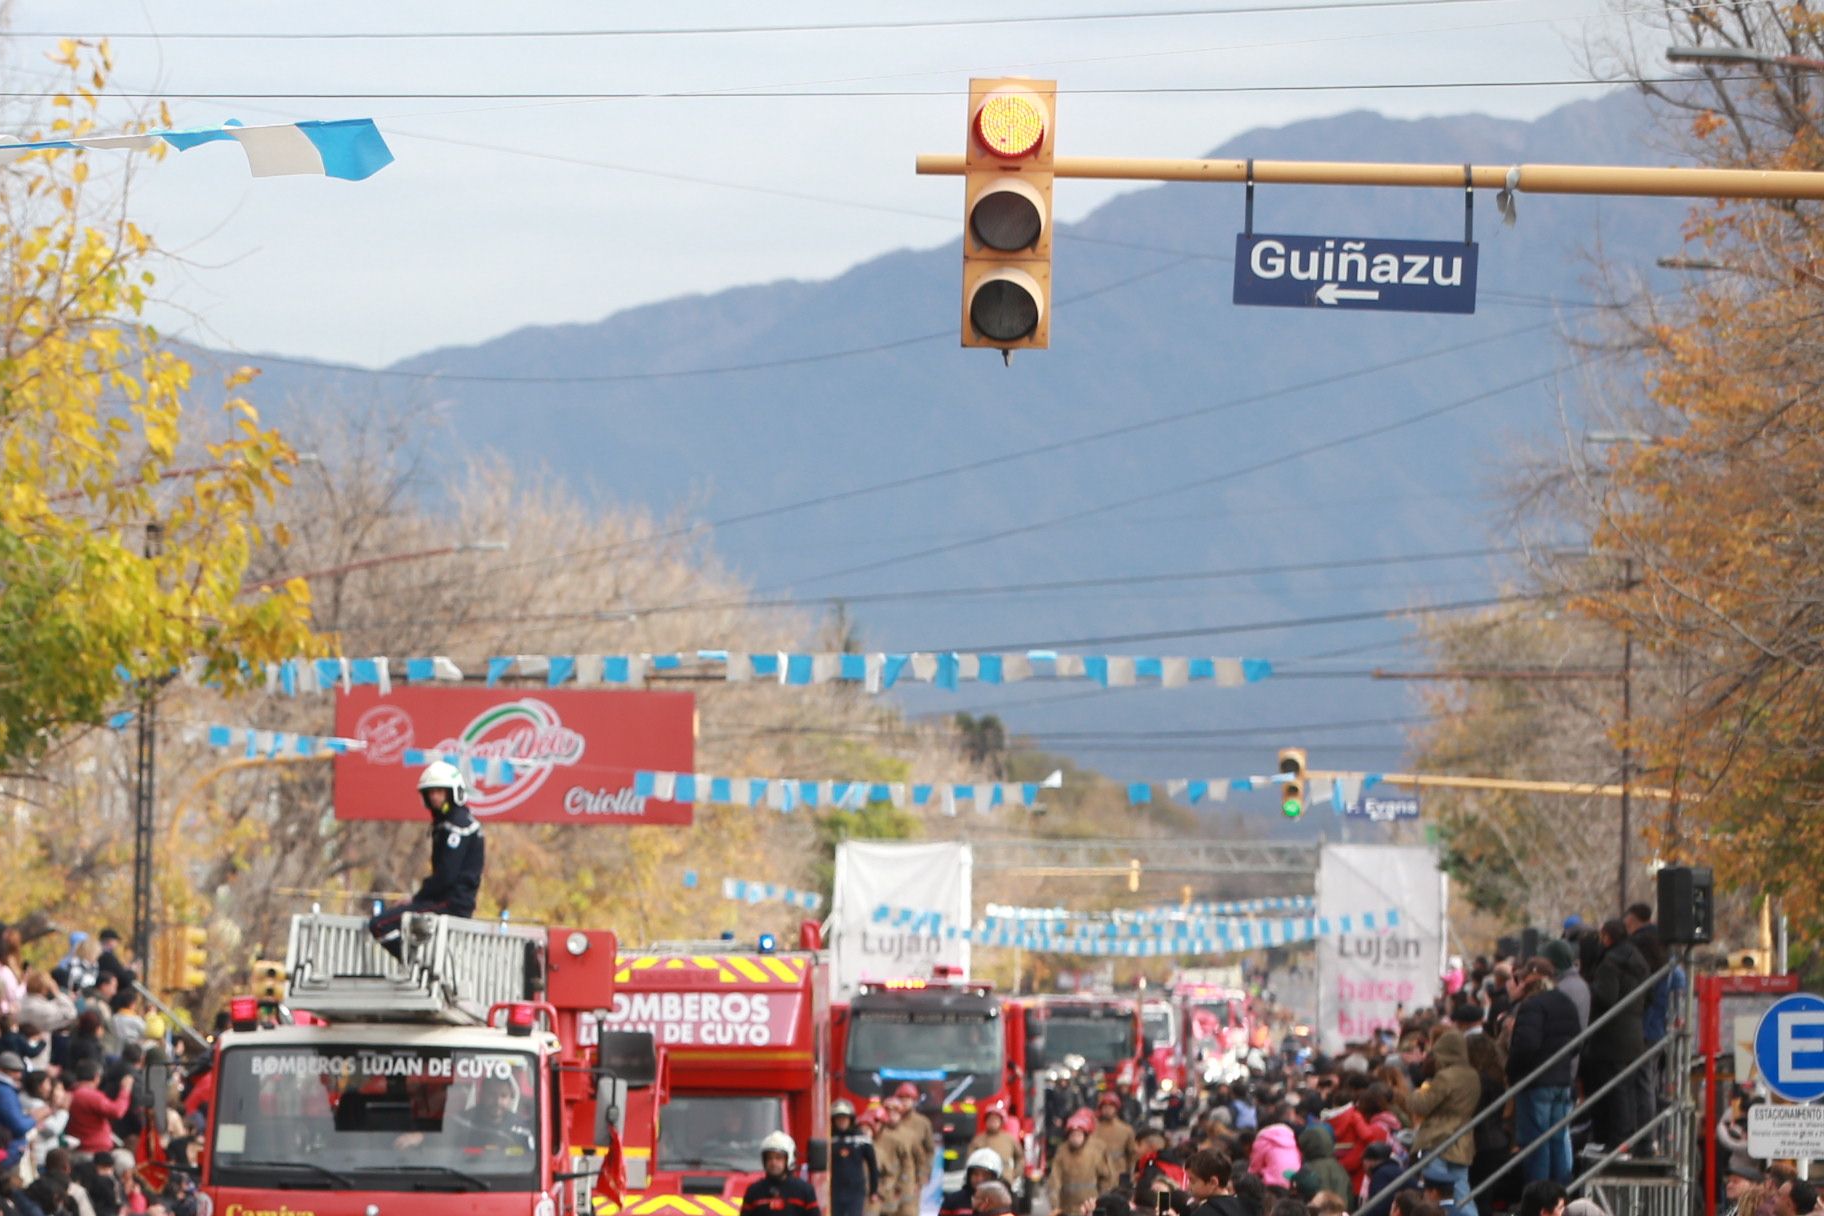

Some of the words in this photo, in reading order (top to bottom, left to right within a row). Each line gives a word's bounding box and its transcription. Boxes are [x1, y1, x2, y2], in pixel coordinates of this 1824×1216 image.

[1249, 239, 1463, 287] Guiñazu
[581, 992, 771, 1023] OMBEROS
[663, 1023, 697, 1045] DE
[700, 1023, 771, 1046] CUYO
[1778, 1011, 1824, 1083] E
[251, 1055, 356, 1077] BOMBEROS
[362, 1056, 423, 1077] LUJAN
[428, 1058, 453, 1078] DE
[456, 1059, 512, 1080] CUYO
